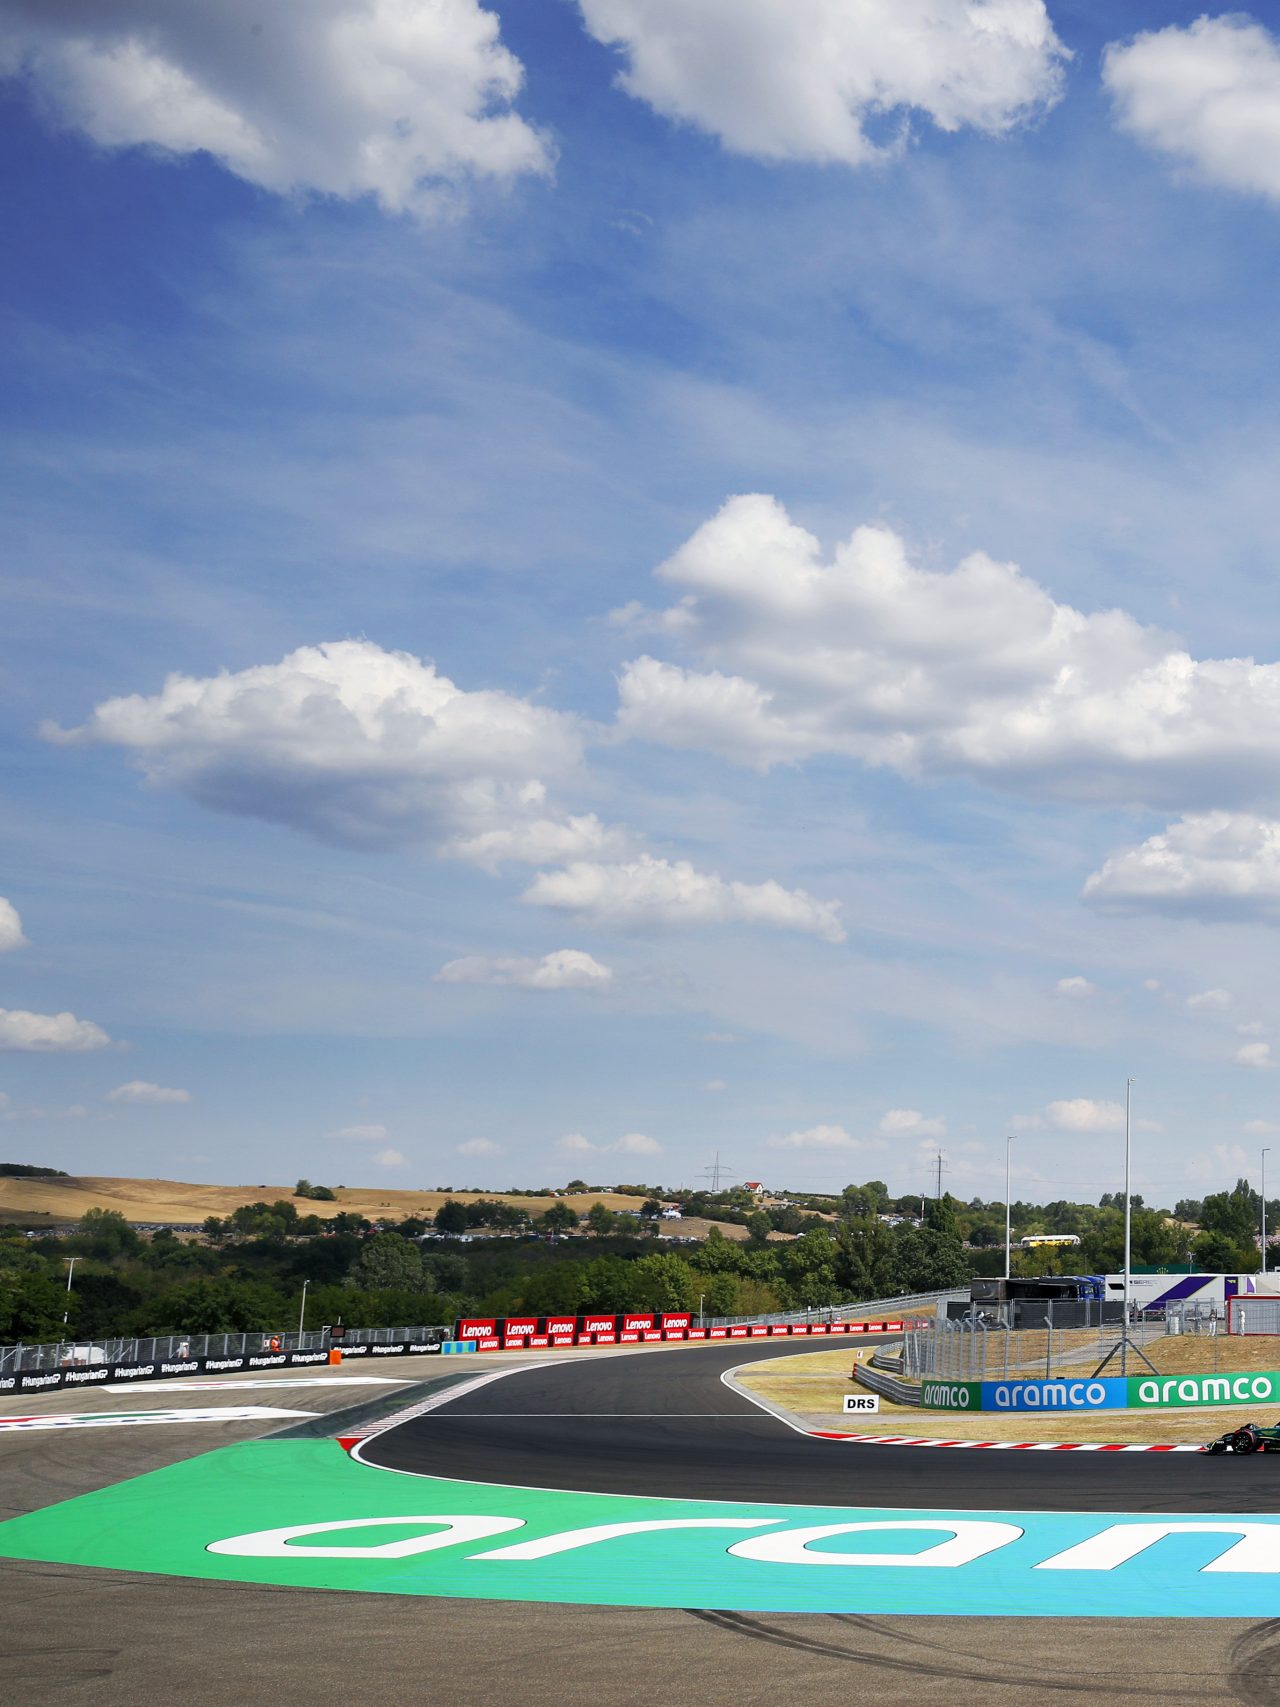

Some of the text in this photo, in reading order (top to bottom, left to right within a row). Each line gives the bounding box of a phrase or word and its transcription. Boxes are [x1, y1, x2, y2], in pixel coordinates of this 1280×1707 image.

[507, 1322, 535, 1335] Lenovo
[548, 1322, 574, 1334] Lenovo
[586, 1321, 613, 1332] Lenovo
[626, 1319, 651, 1330] Lenovo
[664, 1317, 688, 1328] Lenovo
[462, 1324, 493, 1337] Lenovo
[644, 1331, 661, 1340] Lenovo
[505, 1339, 523, 1347] Lenovo
[530, 1337, 548, 1346] Lenovo
[554, 1336, 572, 1345] Lenovo
[621, 1333, 638, 1341] Lenovo
[480, 1340, 498, 1349] Lenovo
[249, 1355, 287, 1367] #HungarianGP
[291, 1352, 328, 1364] #HungarianGP
[161, 1361, 199, 1374] #HungarianGP
[205, 1359, 243, 1370] #HungarianGP
[65, 1369, 109, 1383] #HungarianGP
[114, 1366, 154, 1378] #HungarianGP
[22, 1373, 61, 1387] #HungarianGP
[995, 1380, 1106, 1406] aramco
[1138, 1376, 1273, 1403] aramco
[924, 1384, 970, 1408] aramco
[847, 1399, 875, 1409] DRS
